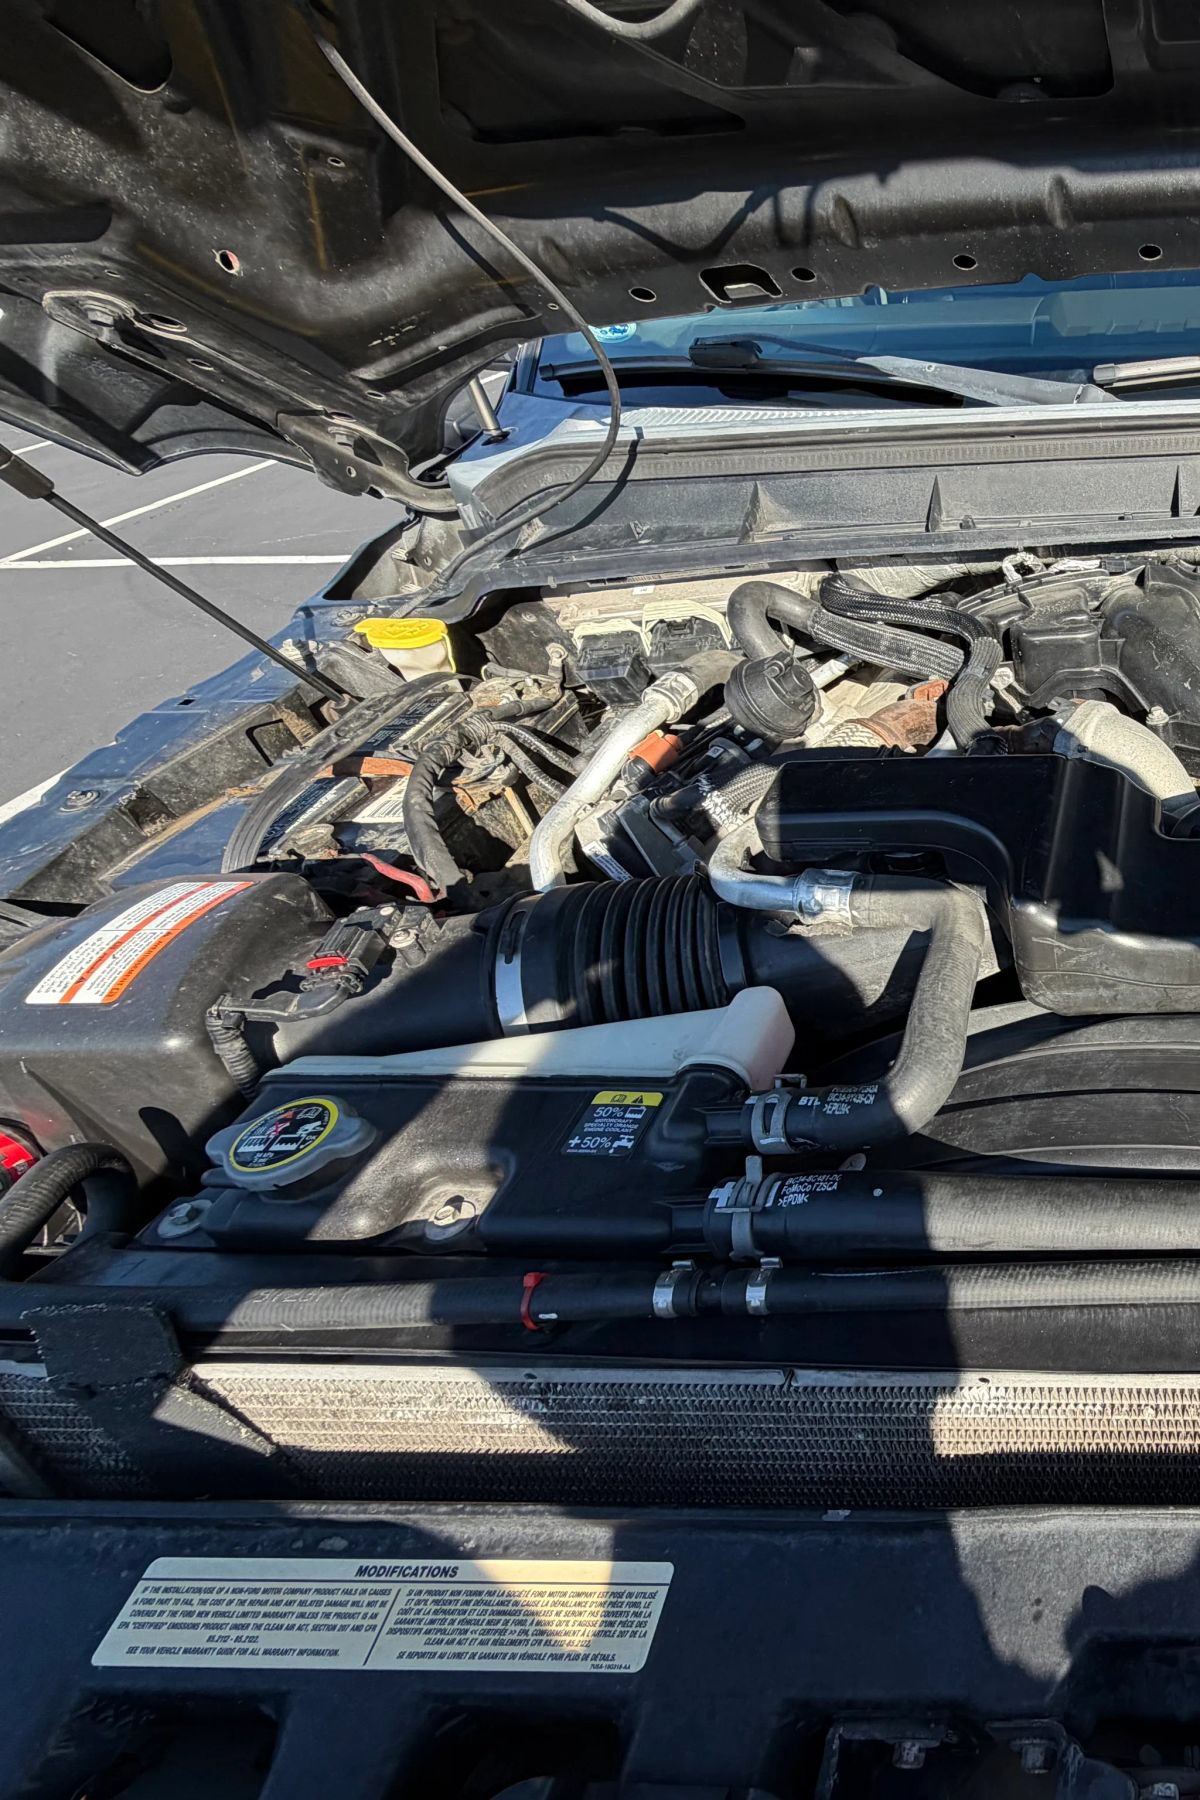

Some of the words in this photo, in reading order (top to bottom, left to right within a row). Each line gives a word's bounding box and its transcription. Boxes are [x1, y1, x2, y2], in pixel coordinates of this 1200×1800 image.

[798, 1096, 821, 1106] BTL
[593, 1106, 624, 1118] 50%
[781, 1183, 811, 1194] FoMoCo
[355, 1565, 459, 1578] MODIFICATIONS
[142, 1586, 149, 1594] IF
[150, 1586, 161, 1594] THE
[217, 1587, 226, 1595] OF
[225, 1587, 231, 1595] A
[231, 1587, 262, 1595] NON-FORD
[261, 1587, 283, 1595] MOTOR
[312, 1588, 342, 1596] PRODUCT
[342, 1588, 359, 1596] FAILS
[358, 1588, 368, 1596] OR
[406, 1589, 414, 1597] SI
[414, 1589, 424, 1597] UN
[423, 1589, 450, 1597] PRODUIT
[449, 1589, 463, 1597] NON
[462, 1590, 485, 1598] FOURNI
[484, 1590, 498, 1598] PAR
[497, 1590, 507, 1598] LA
[506, 1590, 531, 1598] SOCIÉTÉ
[529, 1590, 549, 1598] FORD
[548, 1590, 569, 1599] MOTOR
[568, 1591, 598, 1599] COMPANY
[597, 1591, 611, 1599] EST
[610, 1591, 626, 1599] POSÉ
[625, 1591, 635, 1599] OU
[635, 1591, 659, 1600] UTILISÉ
[133, 1598, 139, 1606] A
[140, 1598, 156, 1606] FORD
[156, 1598, 173, 1606] PART
[173, 1598, 183, 1606] TO
[197, 1598, 209, 1606] THE
[269, 1599, 283, 1607] AND
[283, 1599, 298, 1607] ANY
[297, 1599, 325, 1607] RELATED
[129, 1609, 158, 1617] COVERED
[166, 1610, 179, 1618] THE
[179, 1610, 197, 1618] FORD
[196, 1610, 212, 1618] NEW
[211, 1610, 237, 1618] VEHICLE
[262, 1611, 297, 1619] WARRANTY
[296, 1611, 321, 1619] UNLESS
[320, 1611, 334, 1619] THE
[368, 1612, 379, 1620] AN
[132, 1622, 169, 1630] "CERTIFIED"
[167, 1622, 201, 1630] EMISSIONS
[200, 1622, 230, 1630] PRODUCT
[229, 1623, 251, 1631] UNDER
[251, 1623, 264, 1631] THE
[264, 1623, 285, 1631] CLEAN
[284, 1623, 297, 1631] AIR
[296, 1623, 310, 1631] ACT,
[311, 1624, 338, 1632] SECTION
[339, 1624, 352, 1632] 207
[351, 1624, 364, 1632] AND
[364, 1624, 378, 1632] CFR
[126, 1646, 140, 1654] SEE
[140, 1646, 156, 1654] YOUR
[156, 1647, 183, 1655] VEHICLE
[182, 1647, 217, 1655] WARRANTY
[216, 1647, 237, 1655] GUIDE
[236, 1647, 250, 1655] FOR
[249, 1648, 262, 1656] ALL
[262, 1648, 298, 1656] WARRANTY
[396, 1651, 406, 1660] SE
[406, 1652, 438, 1660] REPORTER
[437, 1652, 447, 1660] AU
[447, 1652, 469, 1661] LIVRET
[468, 1652, 478, 1661] DE
[478, 1652, 508, 1661] GARANTIE
[508, 1652, 518, 1661] DU
[518, 1653, 549, 1661] VÉHICULE
[548, 1653, 565, 1661] POUR
[564, 1653, 581, 1662] PLUS
[581, 1653, 591, 1662] DE
